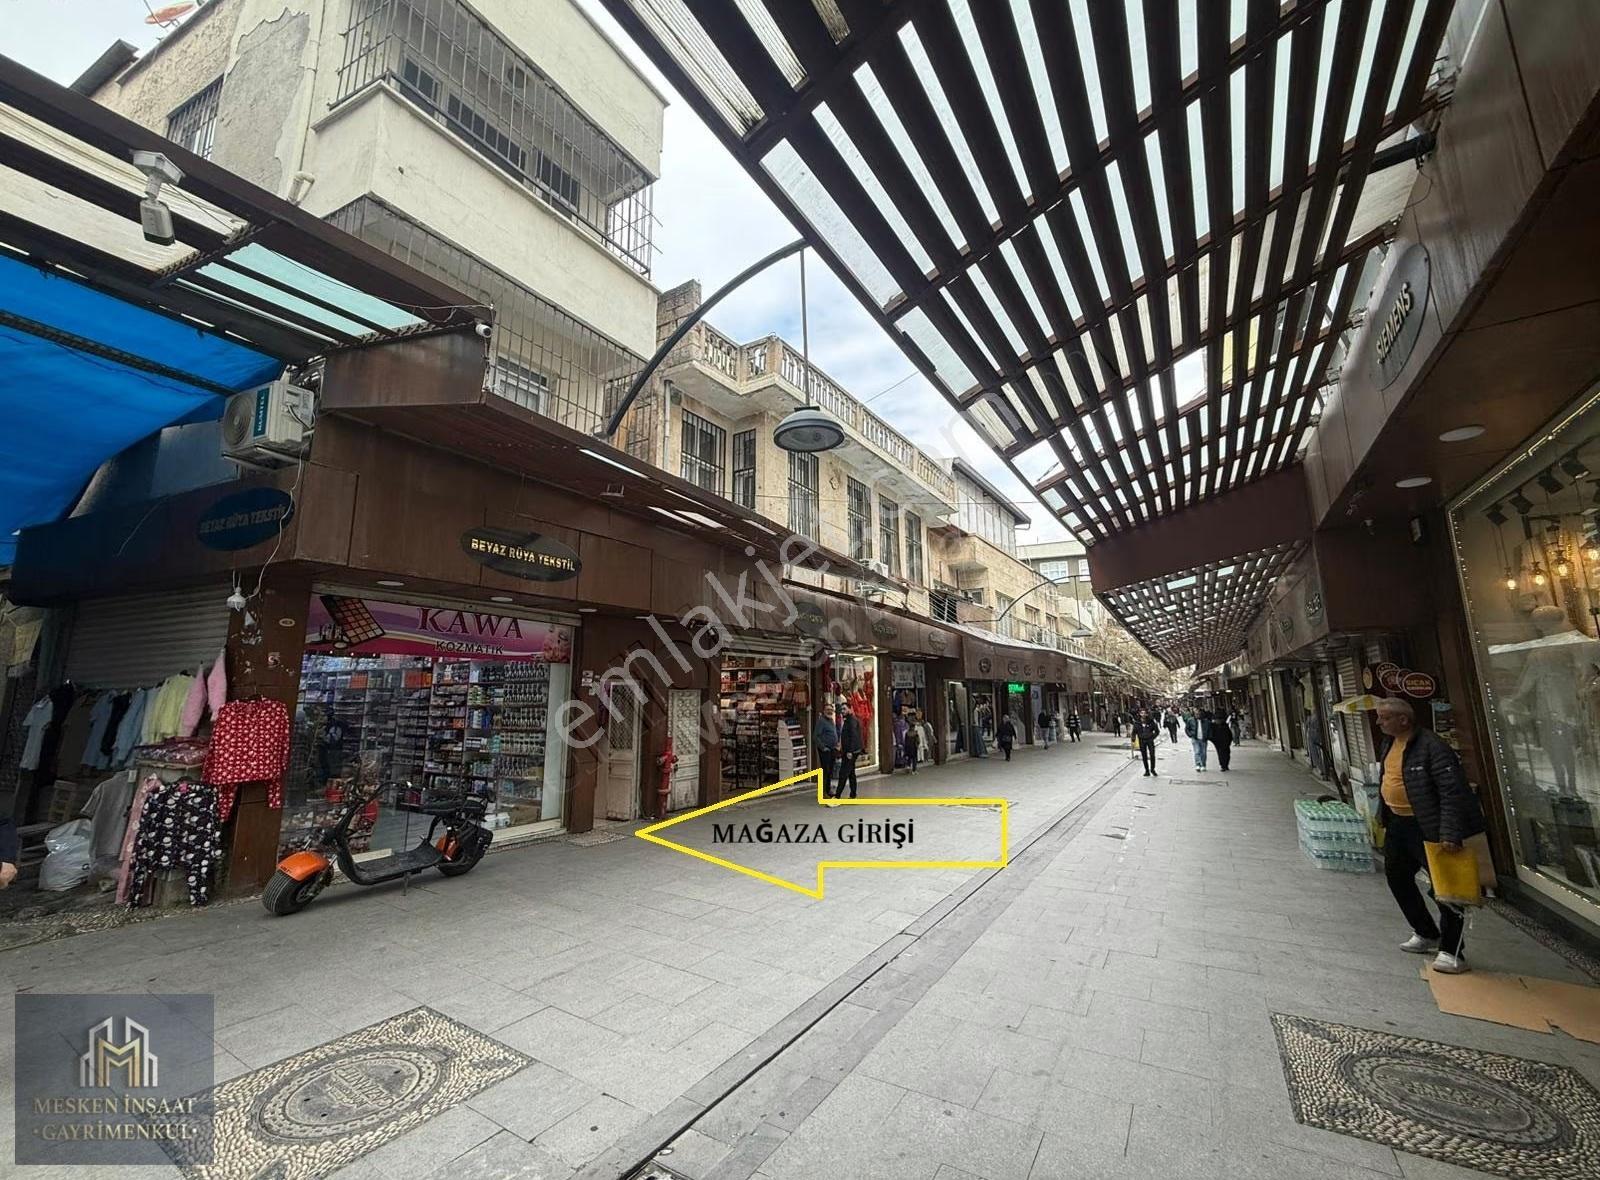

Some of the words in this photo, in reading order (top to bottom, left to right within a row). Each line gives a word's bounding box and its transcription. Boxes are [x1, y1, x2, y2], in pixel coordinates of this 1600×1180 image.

[1375, 282, 1413, 363] SIEMENS
[471, 537, 508, 558] BEYAZ
[508, 546, 536, 563] RÜYA
[537, 552, 577, 573] TEKSTİL
[417, 607, 524, 640] KAWA
